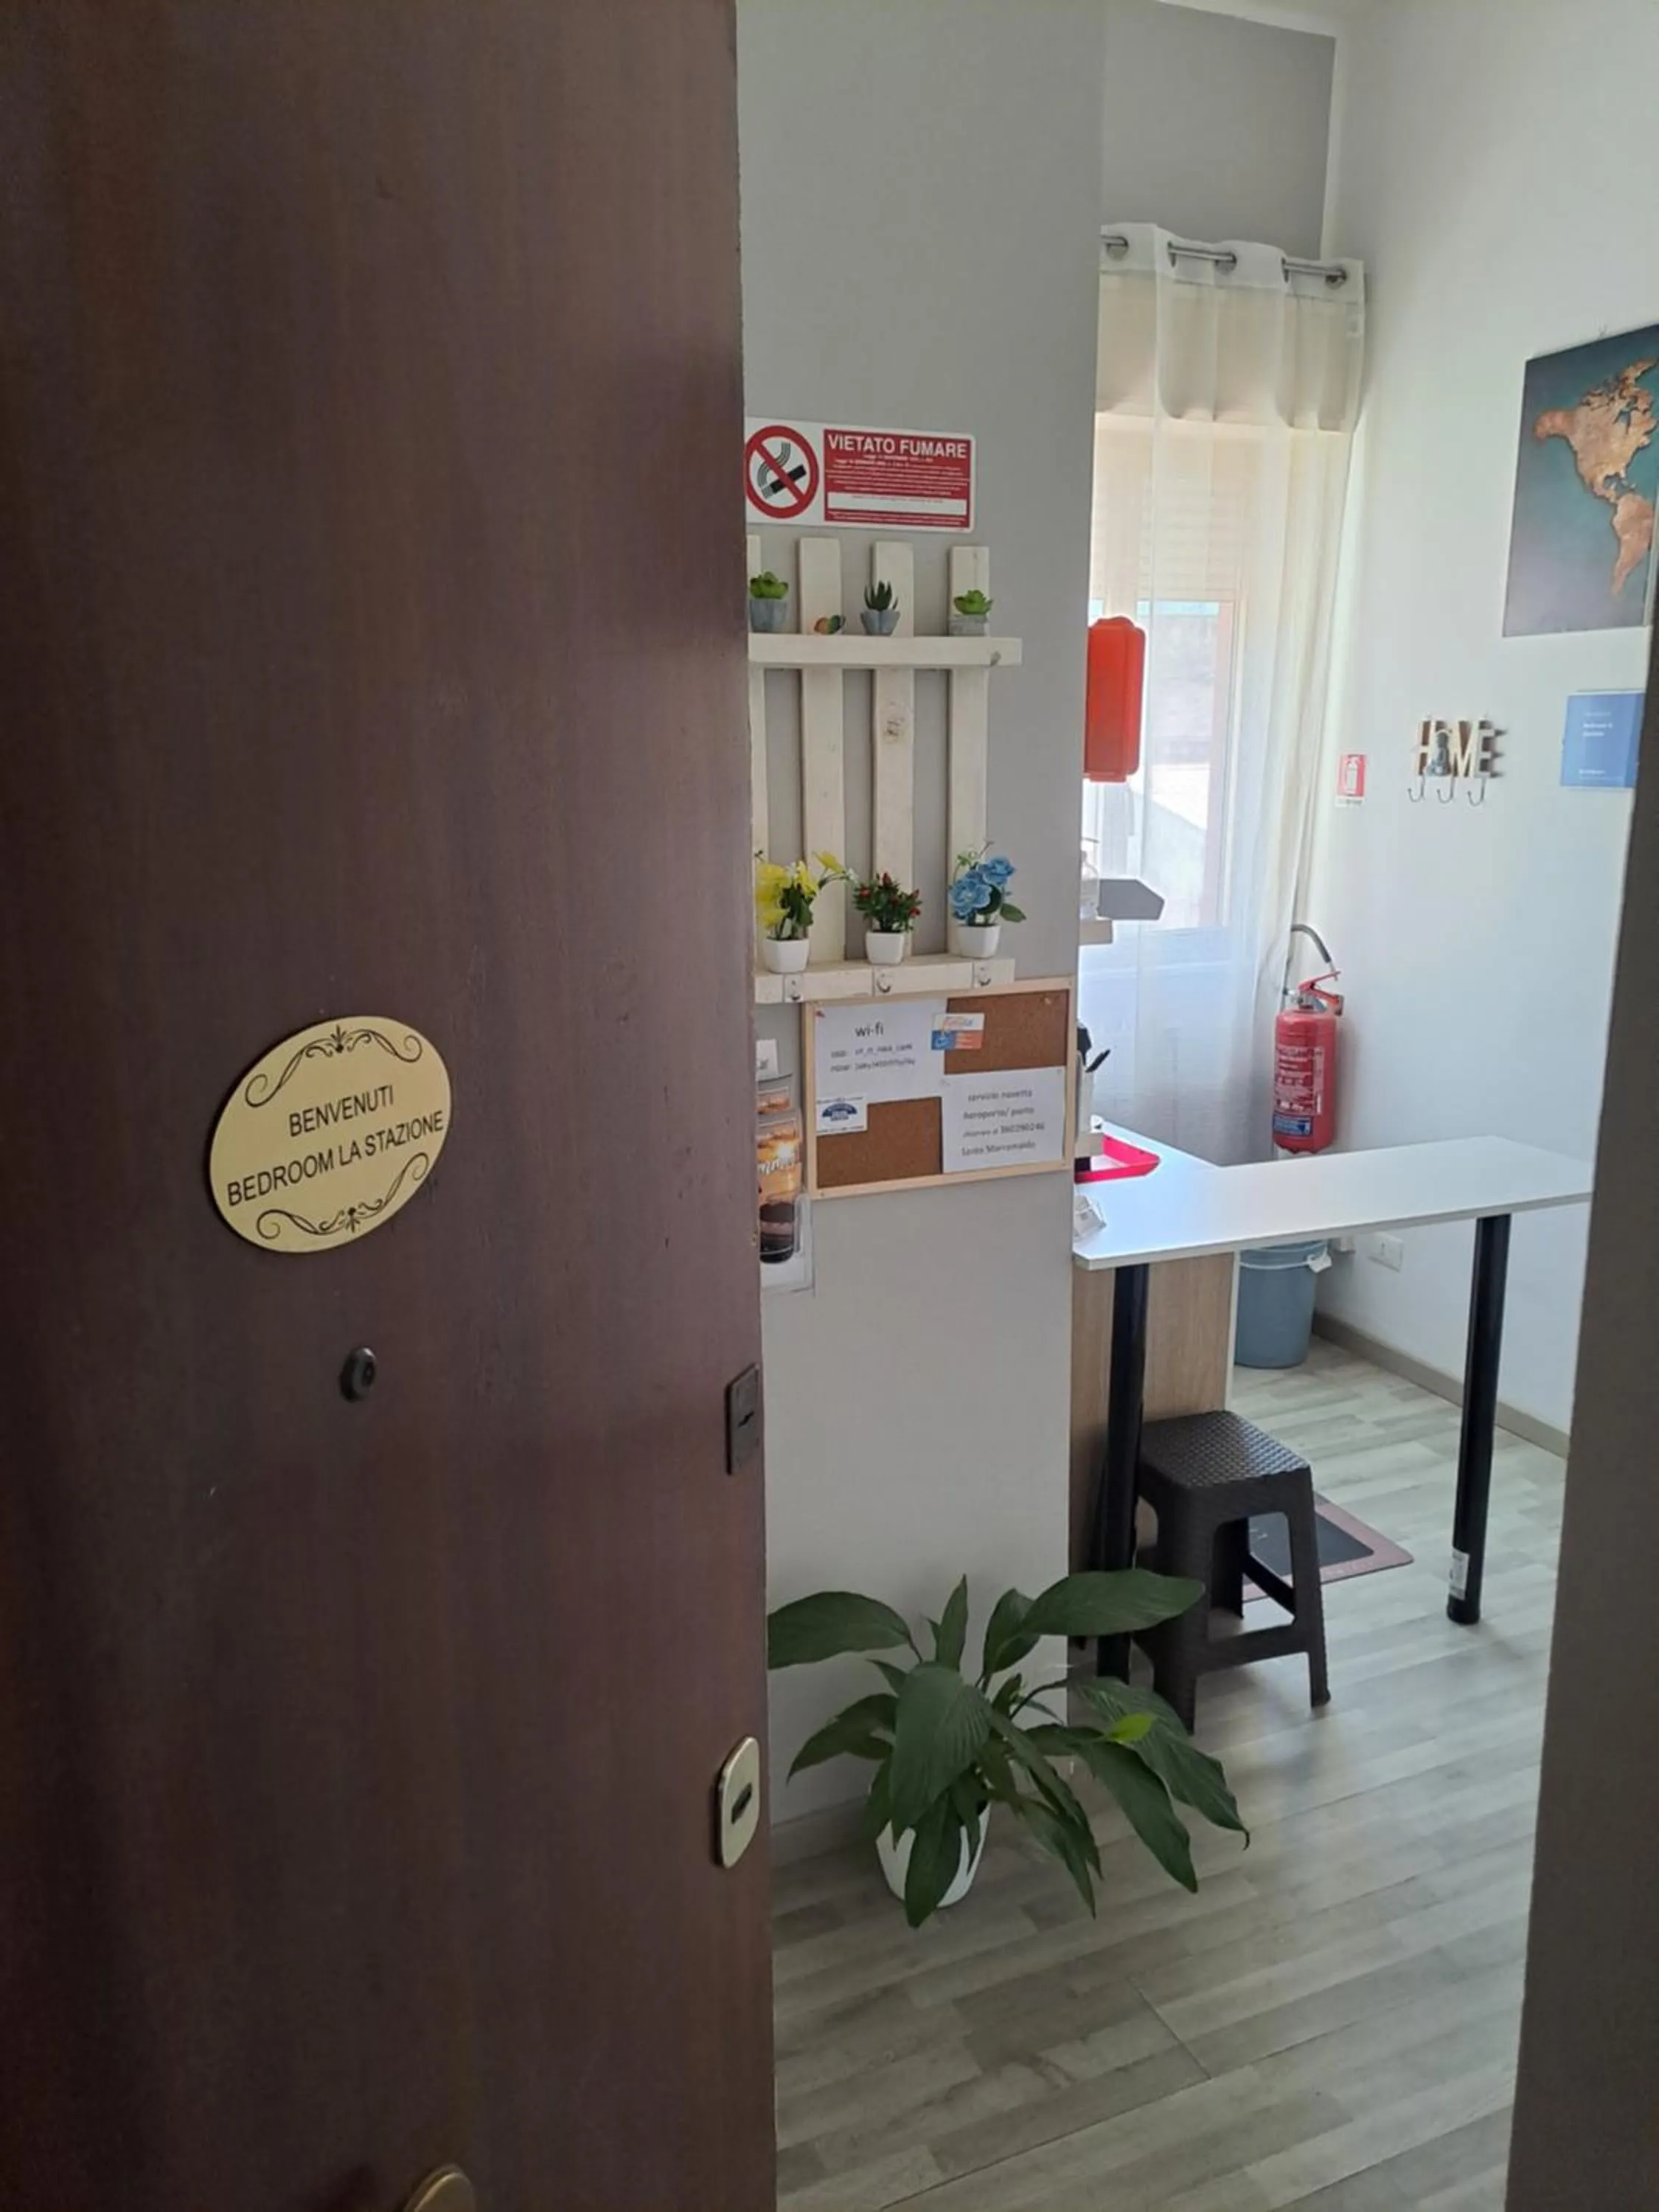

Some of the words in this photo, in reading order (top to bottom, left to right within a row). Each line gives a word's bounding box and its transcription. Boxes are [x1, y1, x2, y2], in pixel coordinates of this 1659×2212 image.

[827, 433, 896, 454] VIETATO
[899, 439, 967, 459] FUMARE
[1413, 719, 1497, 779] HME
[854, 1020, 884, 1037] wi-fi
[288, 1084, 394, 1138] BENVENUTI
[226, 1148, 335, 1207] BEDROOM
[338, 1140, 362, 1167] LA
[365, 1110, 445, 1158] STAZIONE
